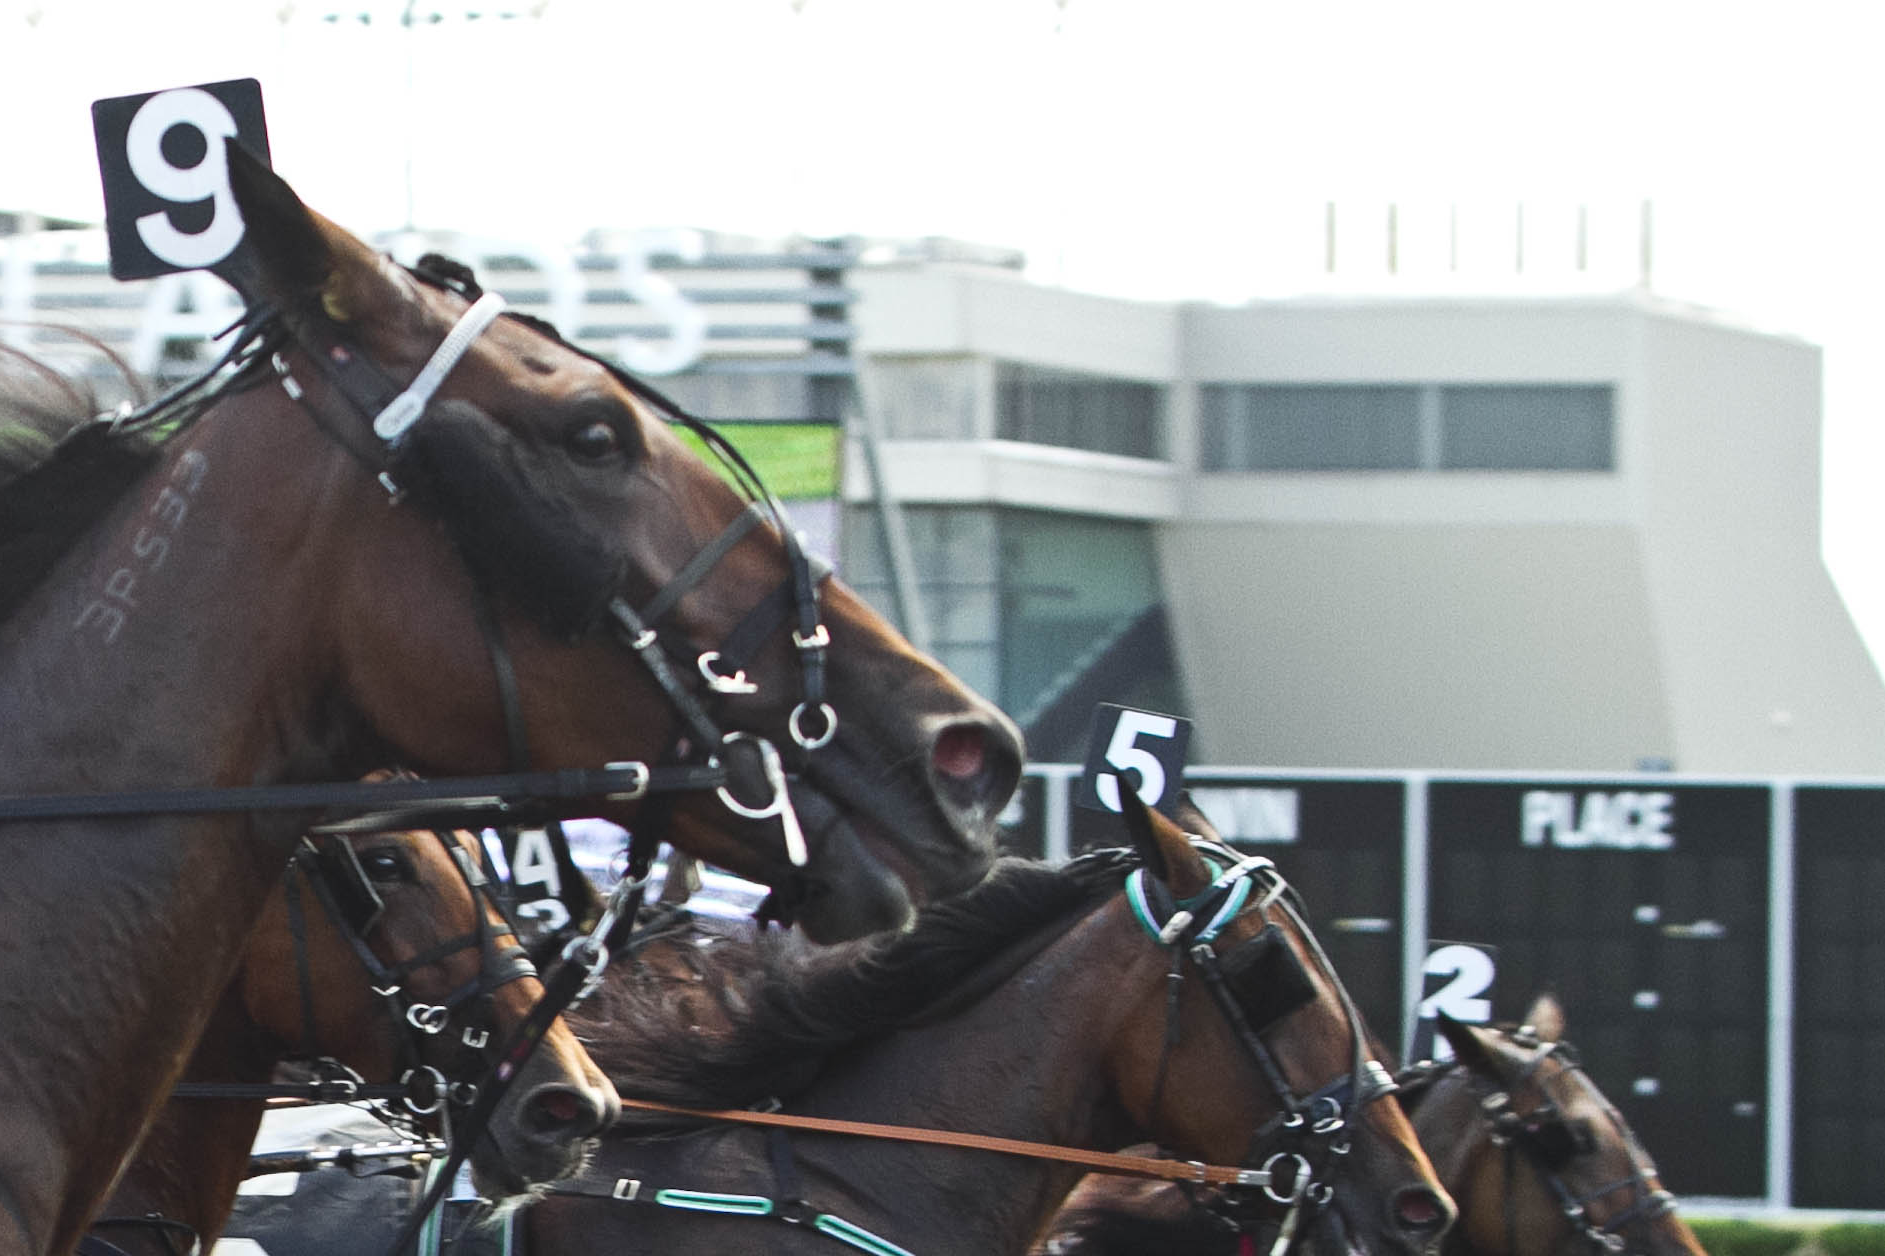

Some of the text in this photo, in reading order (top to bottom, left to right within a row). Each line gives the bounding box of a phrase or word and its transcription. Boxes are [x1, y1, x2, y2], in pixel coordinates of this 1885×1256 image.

[126, 87, 247, 267] 9
[1096, 710, 1177, 813] 5
[1521, 790, 1675, 849] PLACE
[1420, 944, 1495, 1022] 2
